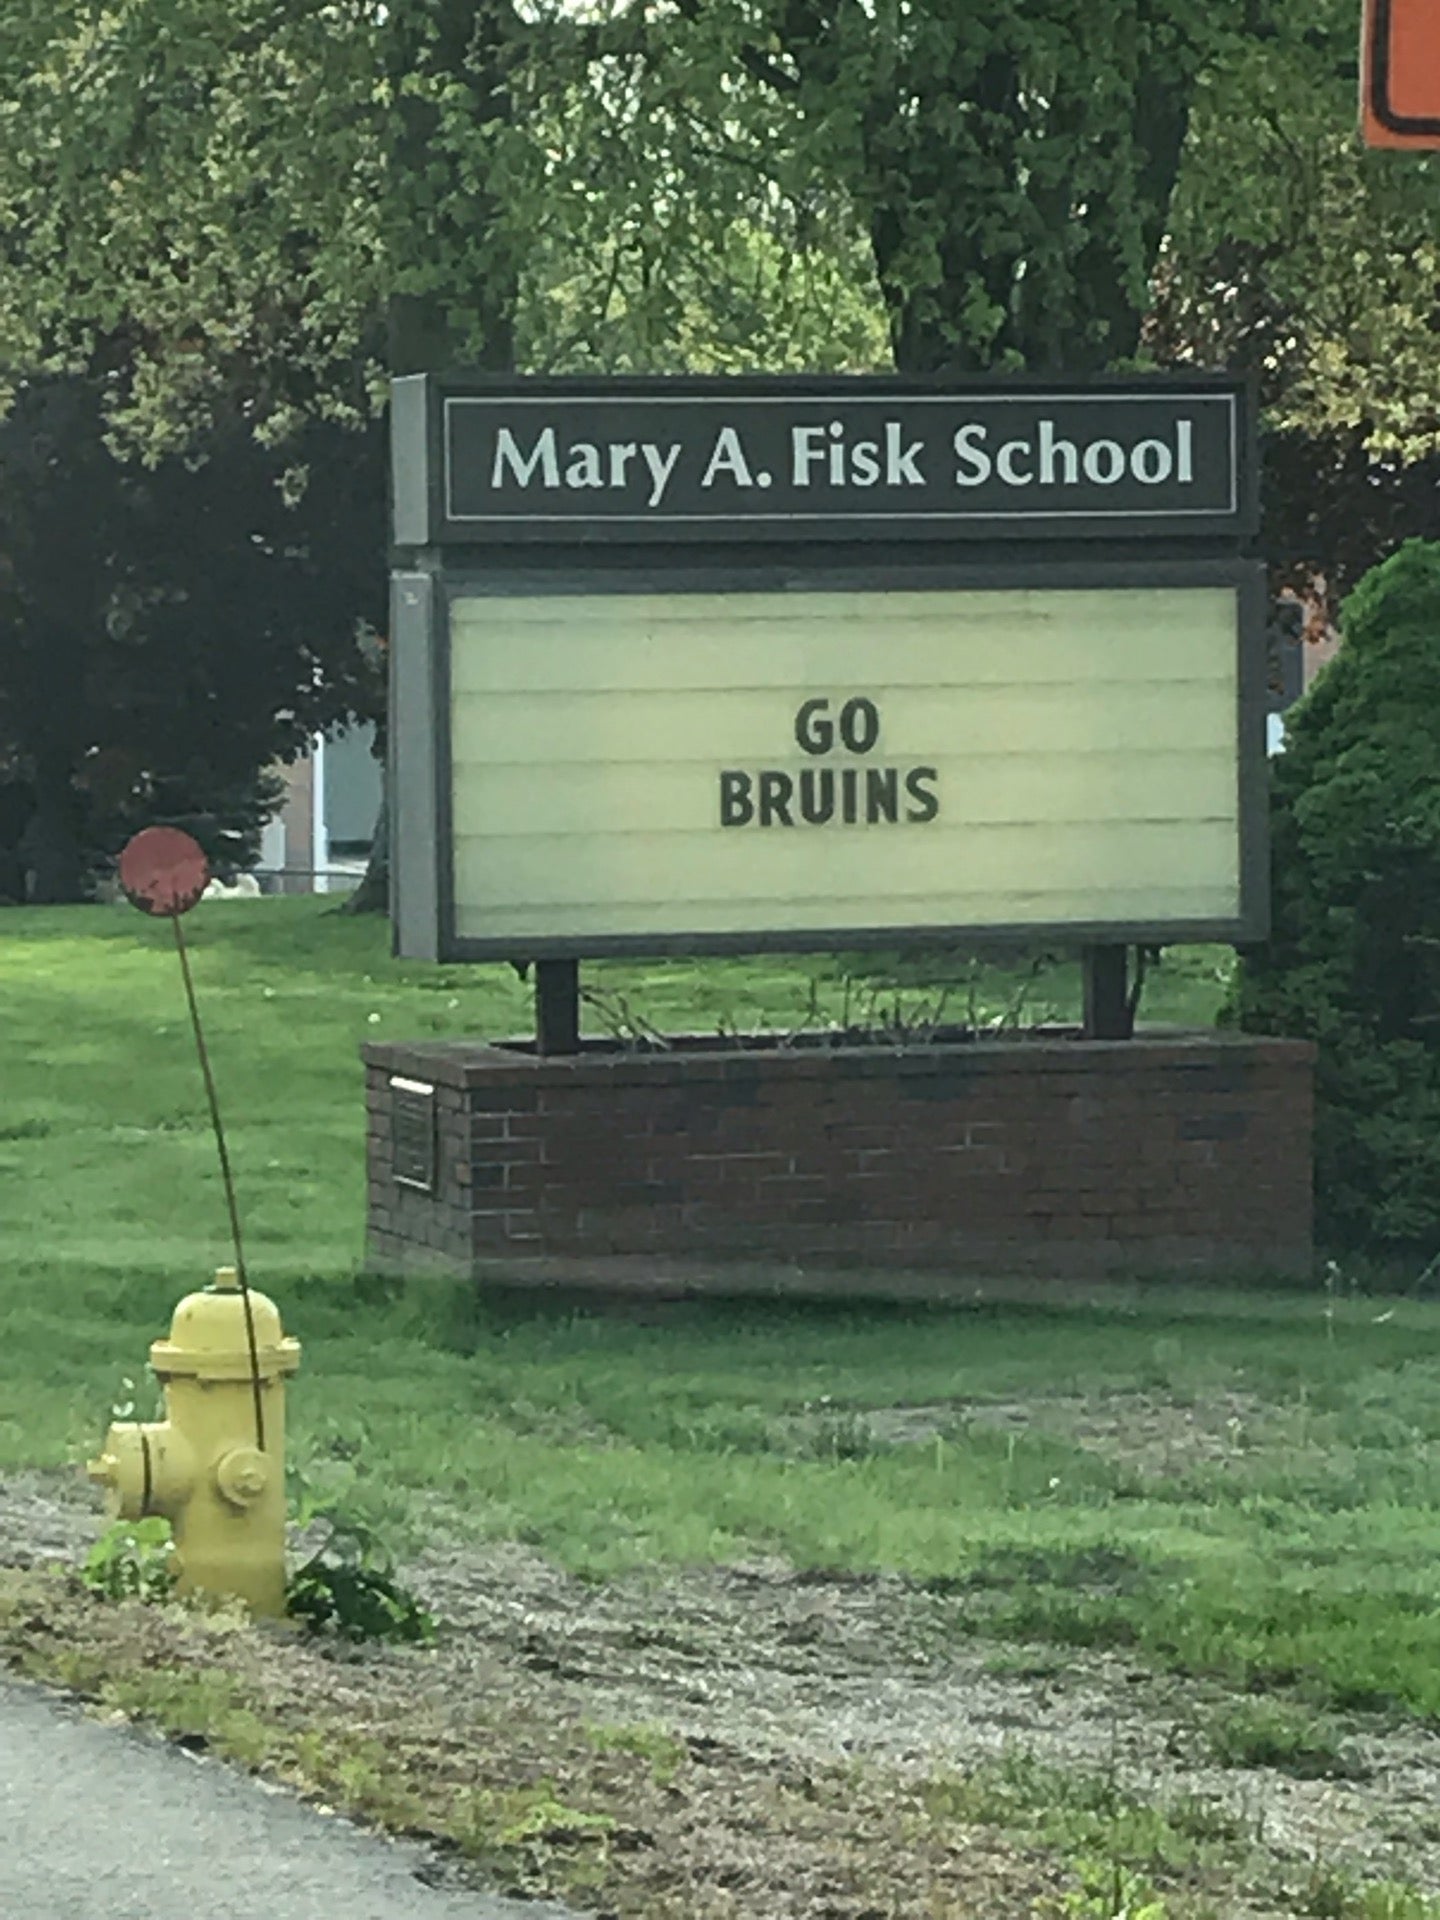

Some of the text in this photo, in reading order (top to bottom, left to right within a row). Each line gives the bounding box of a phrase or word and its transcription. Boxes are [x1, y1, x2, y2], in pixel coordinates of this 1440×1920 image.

[490, 420, 1193, 508] Mary A. Fisk School
[794, 696, 880, 757] GO
[719, 766, 939, 829] BRUINS
